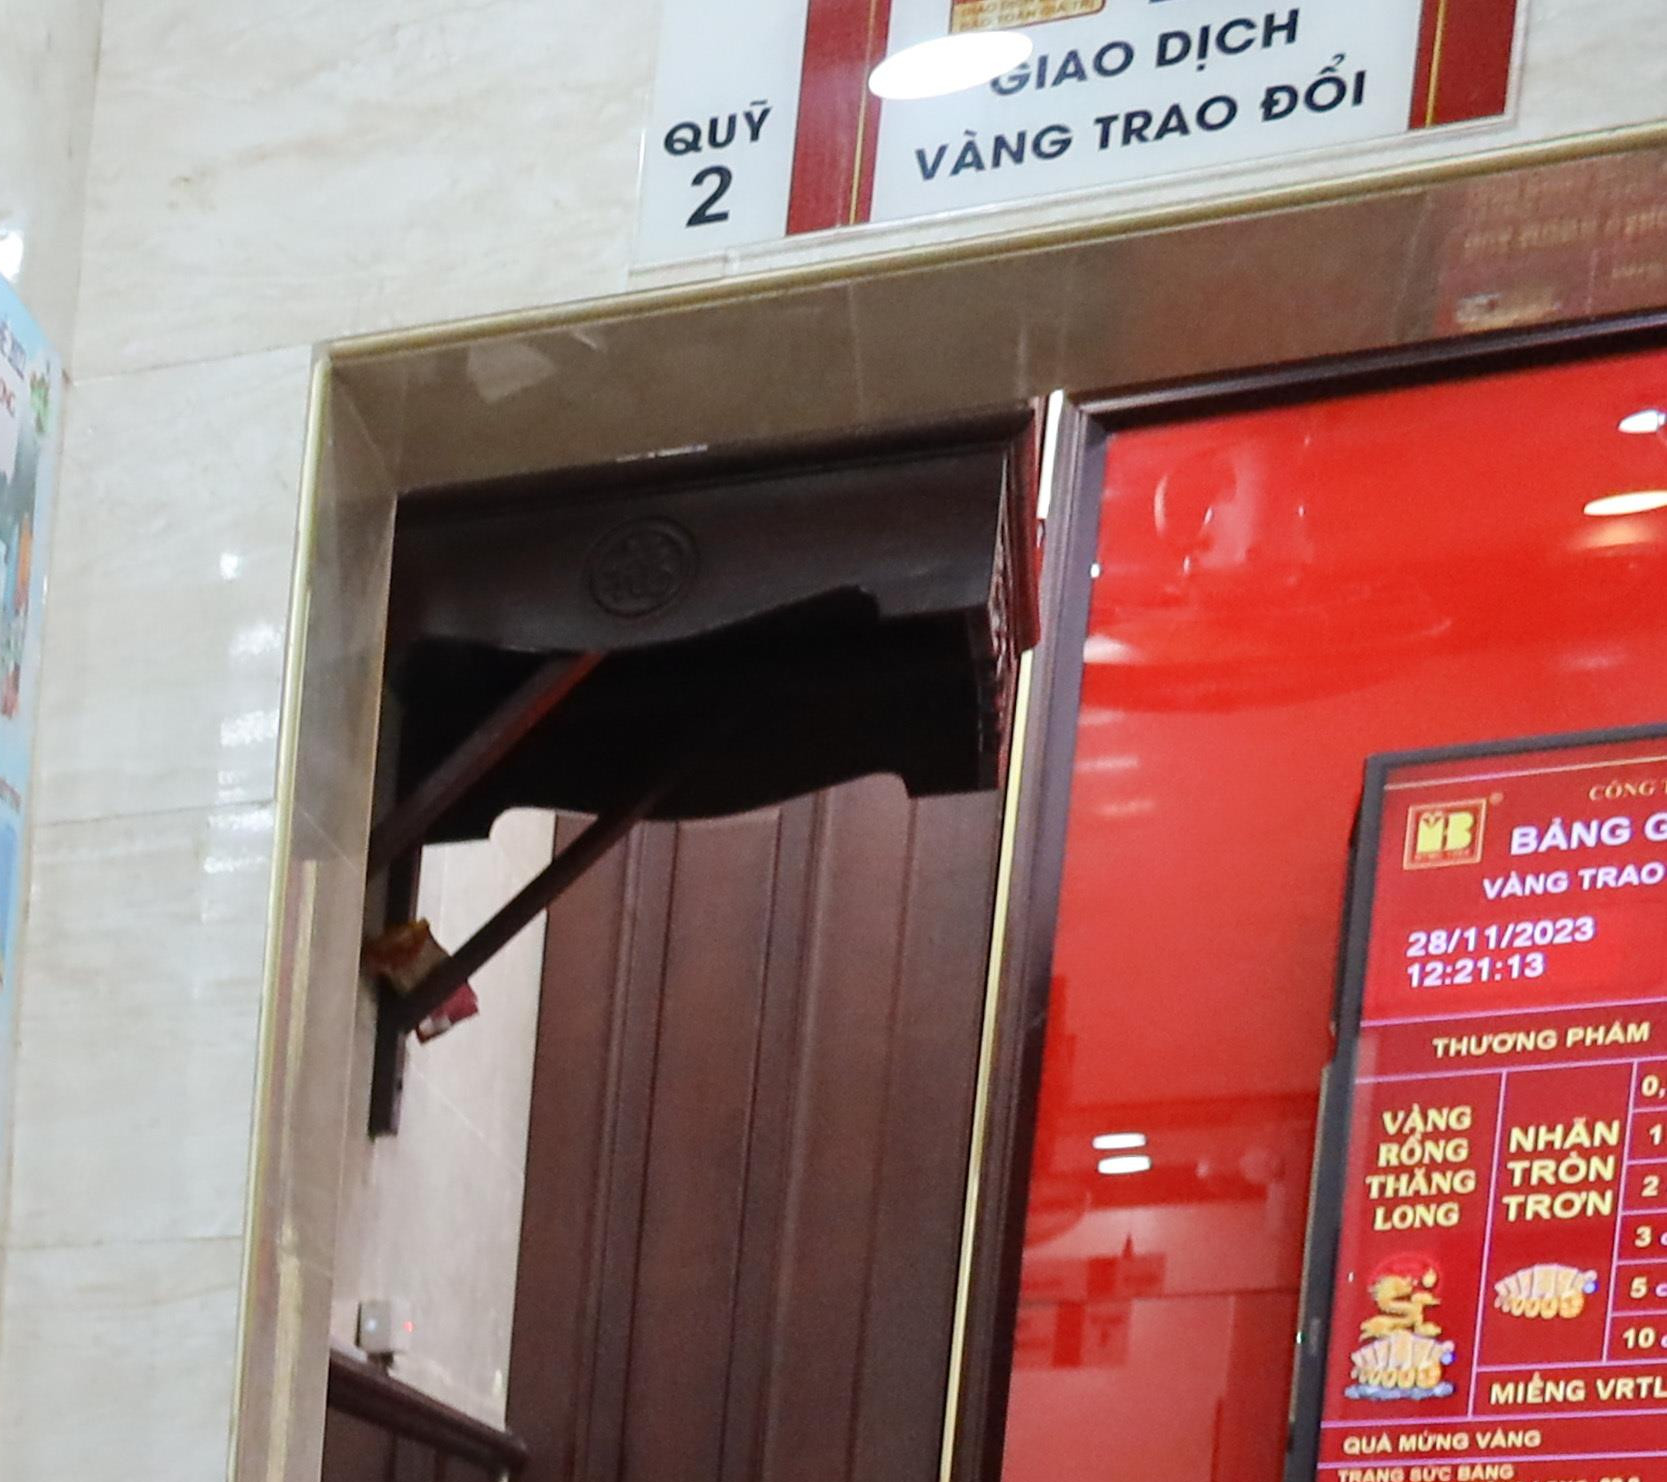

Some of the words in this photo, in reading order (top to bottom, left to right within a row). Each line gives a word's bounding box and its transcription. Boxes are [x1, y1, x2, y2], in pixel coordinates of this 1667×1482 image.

[1156, 8, 1300, 72] DỊCH
[664, 98, 773, 157] QUỸ
[914, 122, 1073, 181] VÀNG
[1095, 96, 1238, 152] TRAO
[1261, 53, 1367, 122] ĐỔI
[685, 164, 733, 228] 2
[1510, 817, 1632, 855] BẢNG
[1483, 870, 1570, 900] VÀNG
[1578, 862, 1666, 890] TRAO
[1406, 916, 1596, 957] 28/11/2023
[1407, 952, 1545, 988] 12:21:13
[1432, 1029, 1558, 1059] THƯƠNG
[1382, 1103, 1473, 1136] VÀNG
[1649, 1124, 1663, 1146] 1
[1378, 1132, 1470, 1168] RỒNG
[1365, 1166, 1477, 1200] THĂNG
[1507, 1151, 1616, 1188] TRÒN
[1641, 1175, 1660, 1197] 2
[1374, 1201, 1461, 1231] LONG
[1502, 1189, 1613, 1222] TRƠN
[1634, 1225, 1652, 1248] 3
[1630, 1277, 1648, 1299] 5
[1623, 1327, 1656, 1350] 10
[1342, 1432, 1393, 1456] QUÀ
[1475, 1427, 1542, 1450] VÀNG
